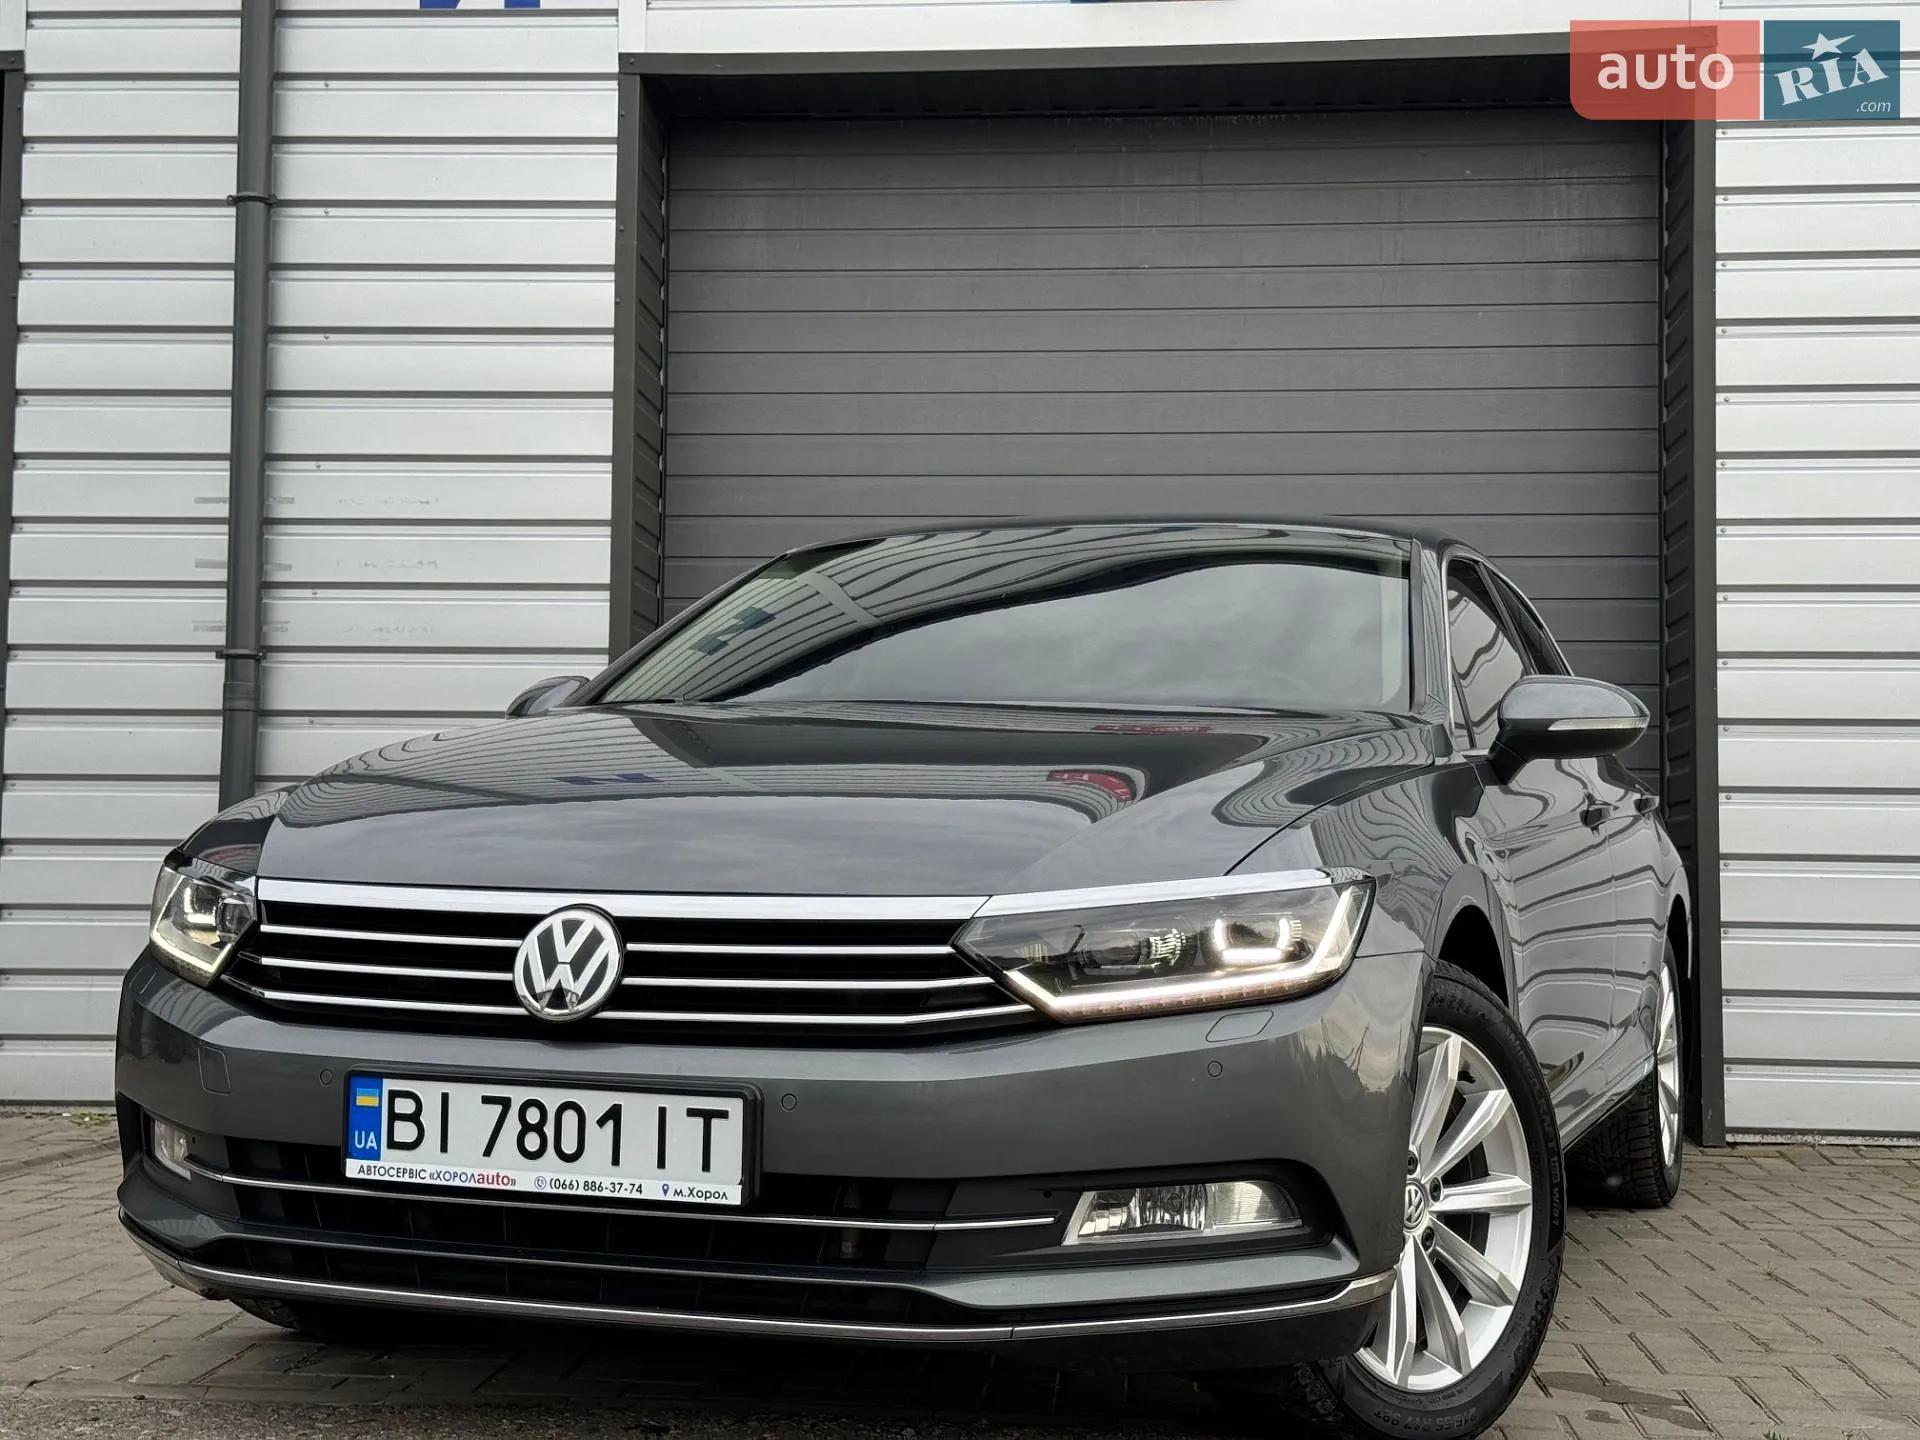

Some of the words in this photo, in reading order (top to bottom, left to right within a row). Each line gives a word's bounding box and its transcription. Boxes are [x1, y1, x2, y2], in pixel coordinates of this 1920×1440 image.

[514, 908, 619, 1016] VW
[354, 1130, 378, 1151] UA
[386, 1088, 451, 1154] BI
[480, 1094, 624, 1167] 7801
[656, 1106, 730, 1173] IT
[357, 1164, 427, 1181] АВТОСЕРВІС
[549, 1178, 580, 1191] (066)
[583, 1181, 643, 1195] 886-37-74
[673, 1188, 729, 1201] м.Хорол
